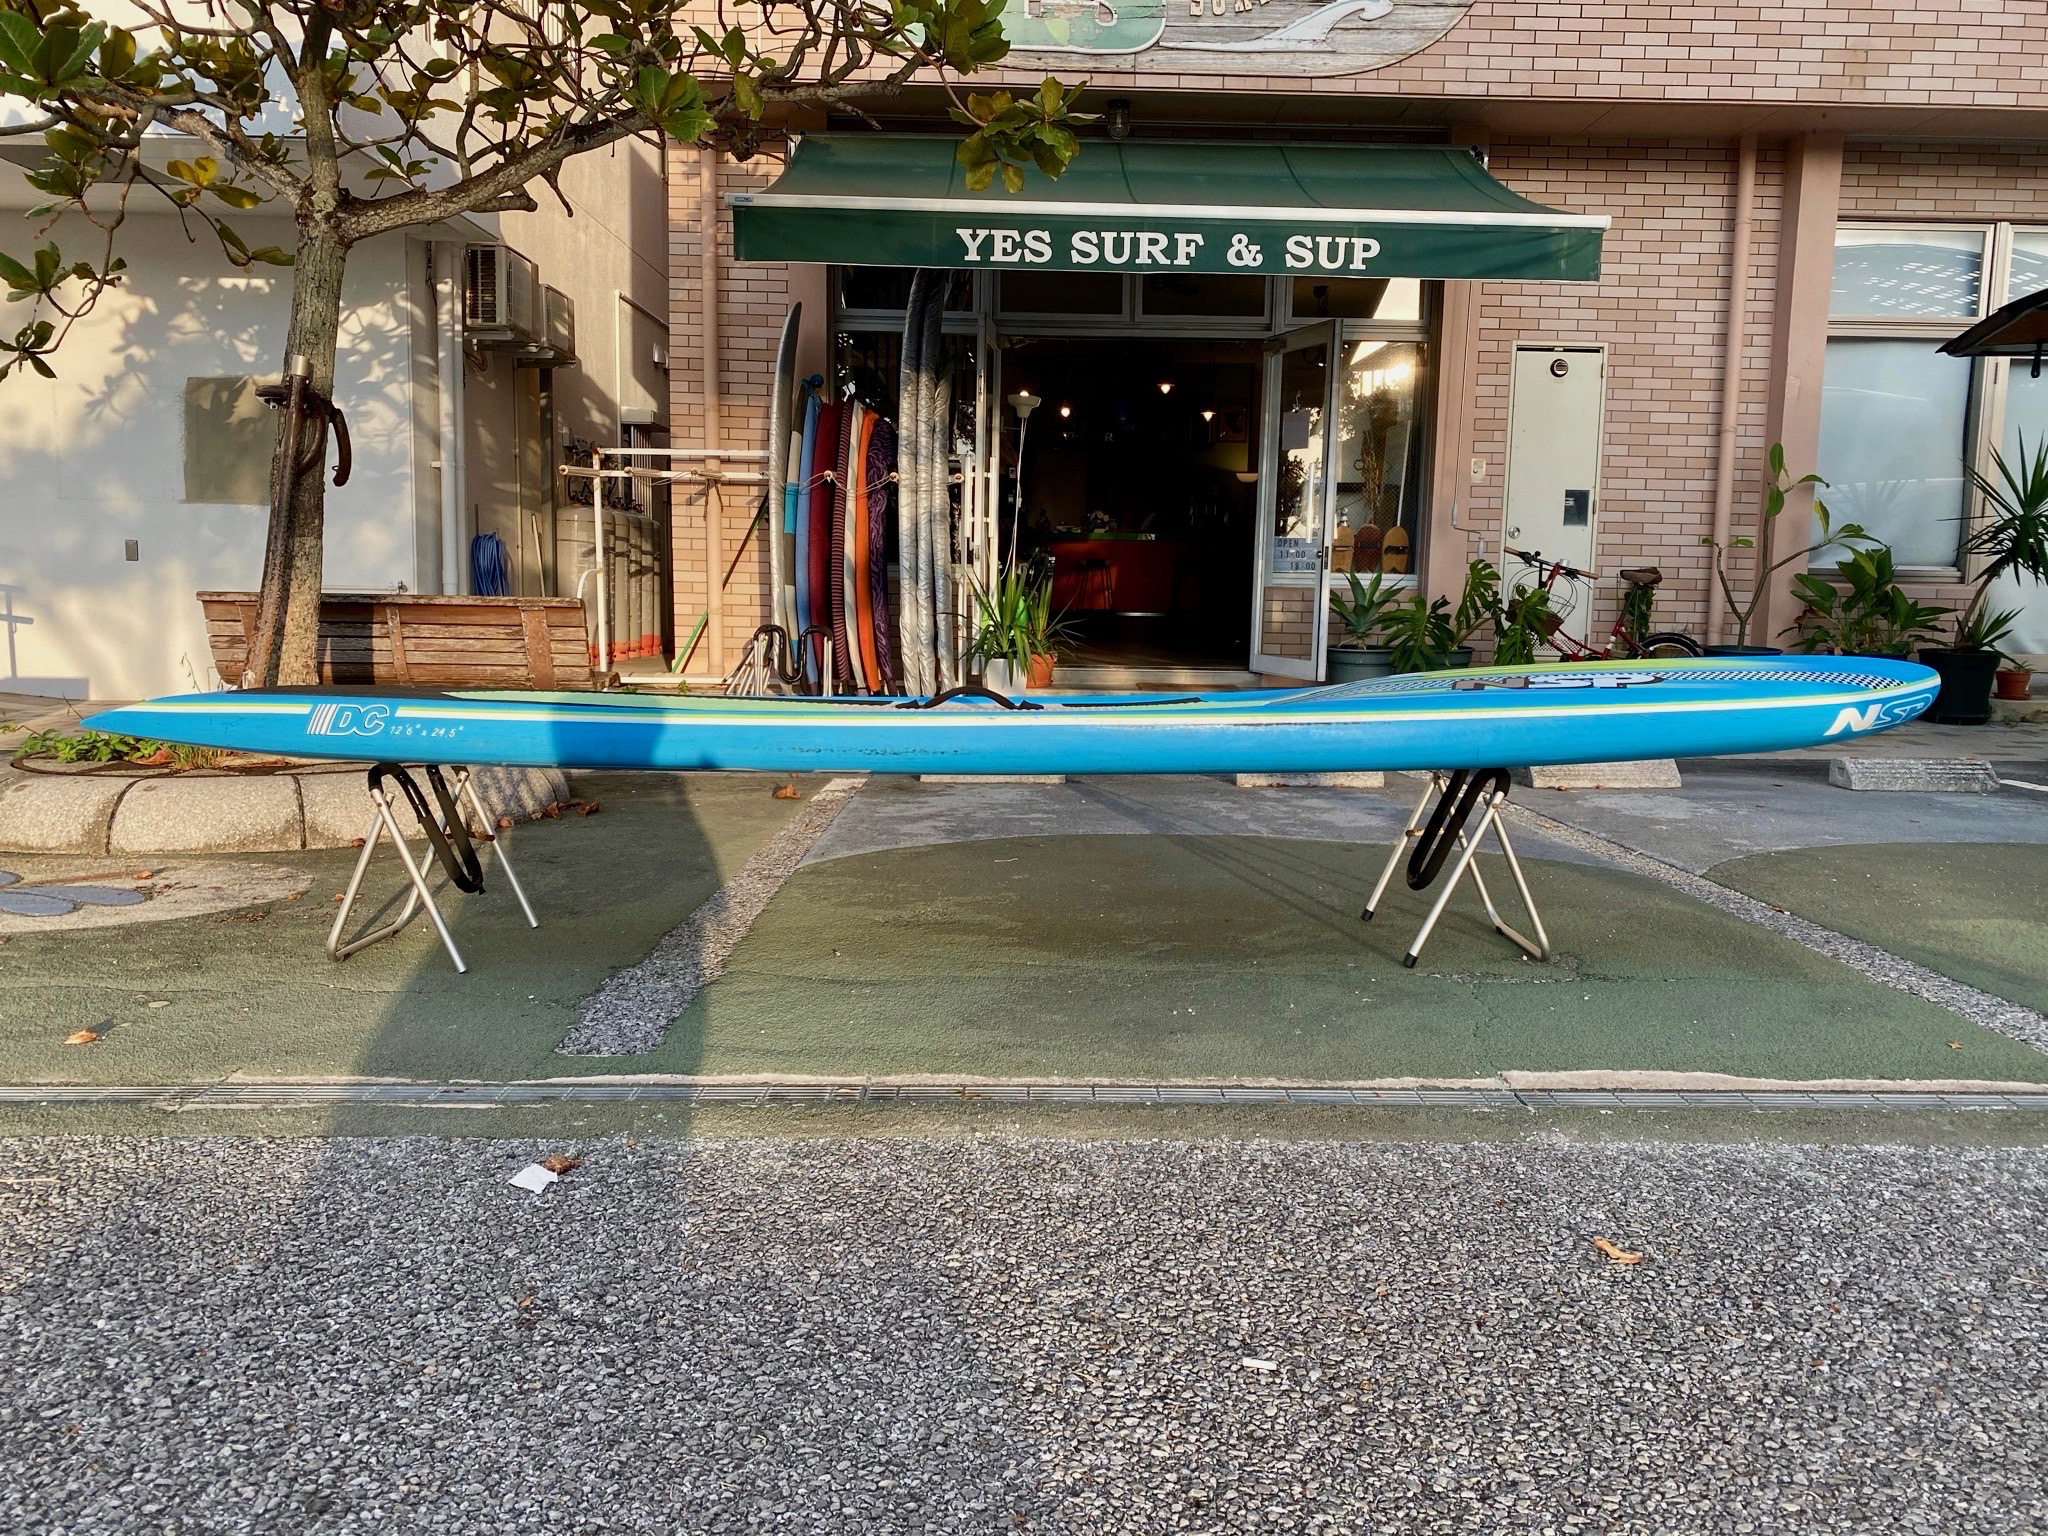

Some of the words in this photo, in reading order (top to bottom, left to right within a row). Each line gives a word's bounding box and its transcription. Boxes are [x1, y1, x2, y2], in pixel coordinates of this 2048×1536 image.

[956, 228, 1053, 263] YES
[1070, 230, 1204, 266] SURF
[1226, 233, 1263, 267] &
[1285, 235, 1381, 270] SUP
[1278, 539, 1299, 547] OPEN
[1450, 673, 1663, 691] NSP
[1823, 693, 1933, 736] NSP
